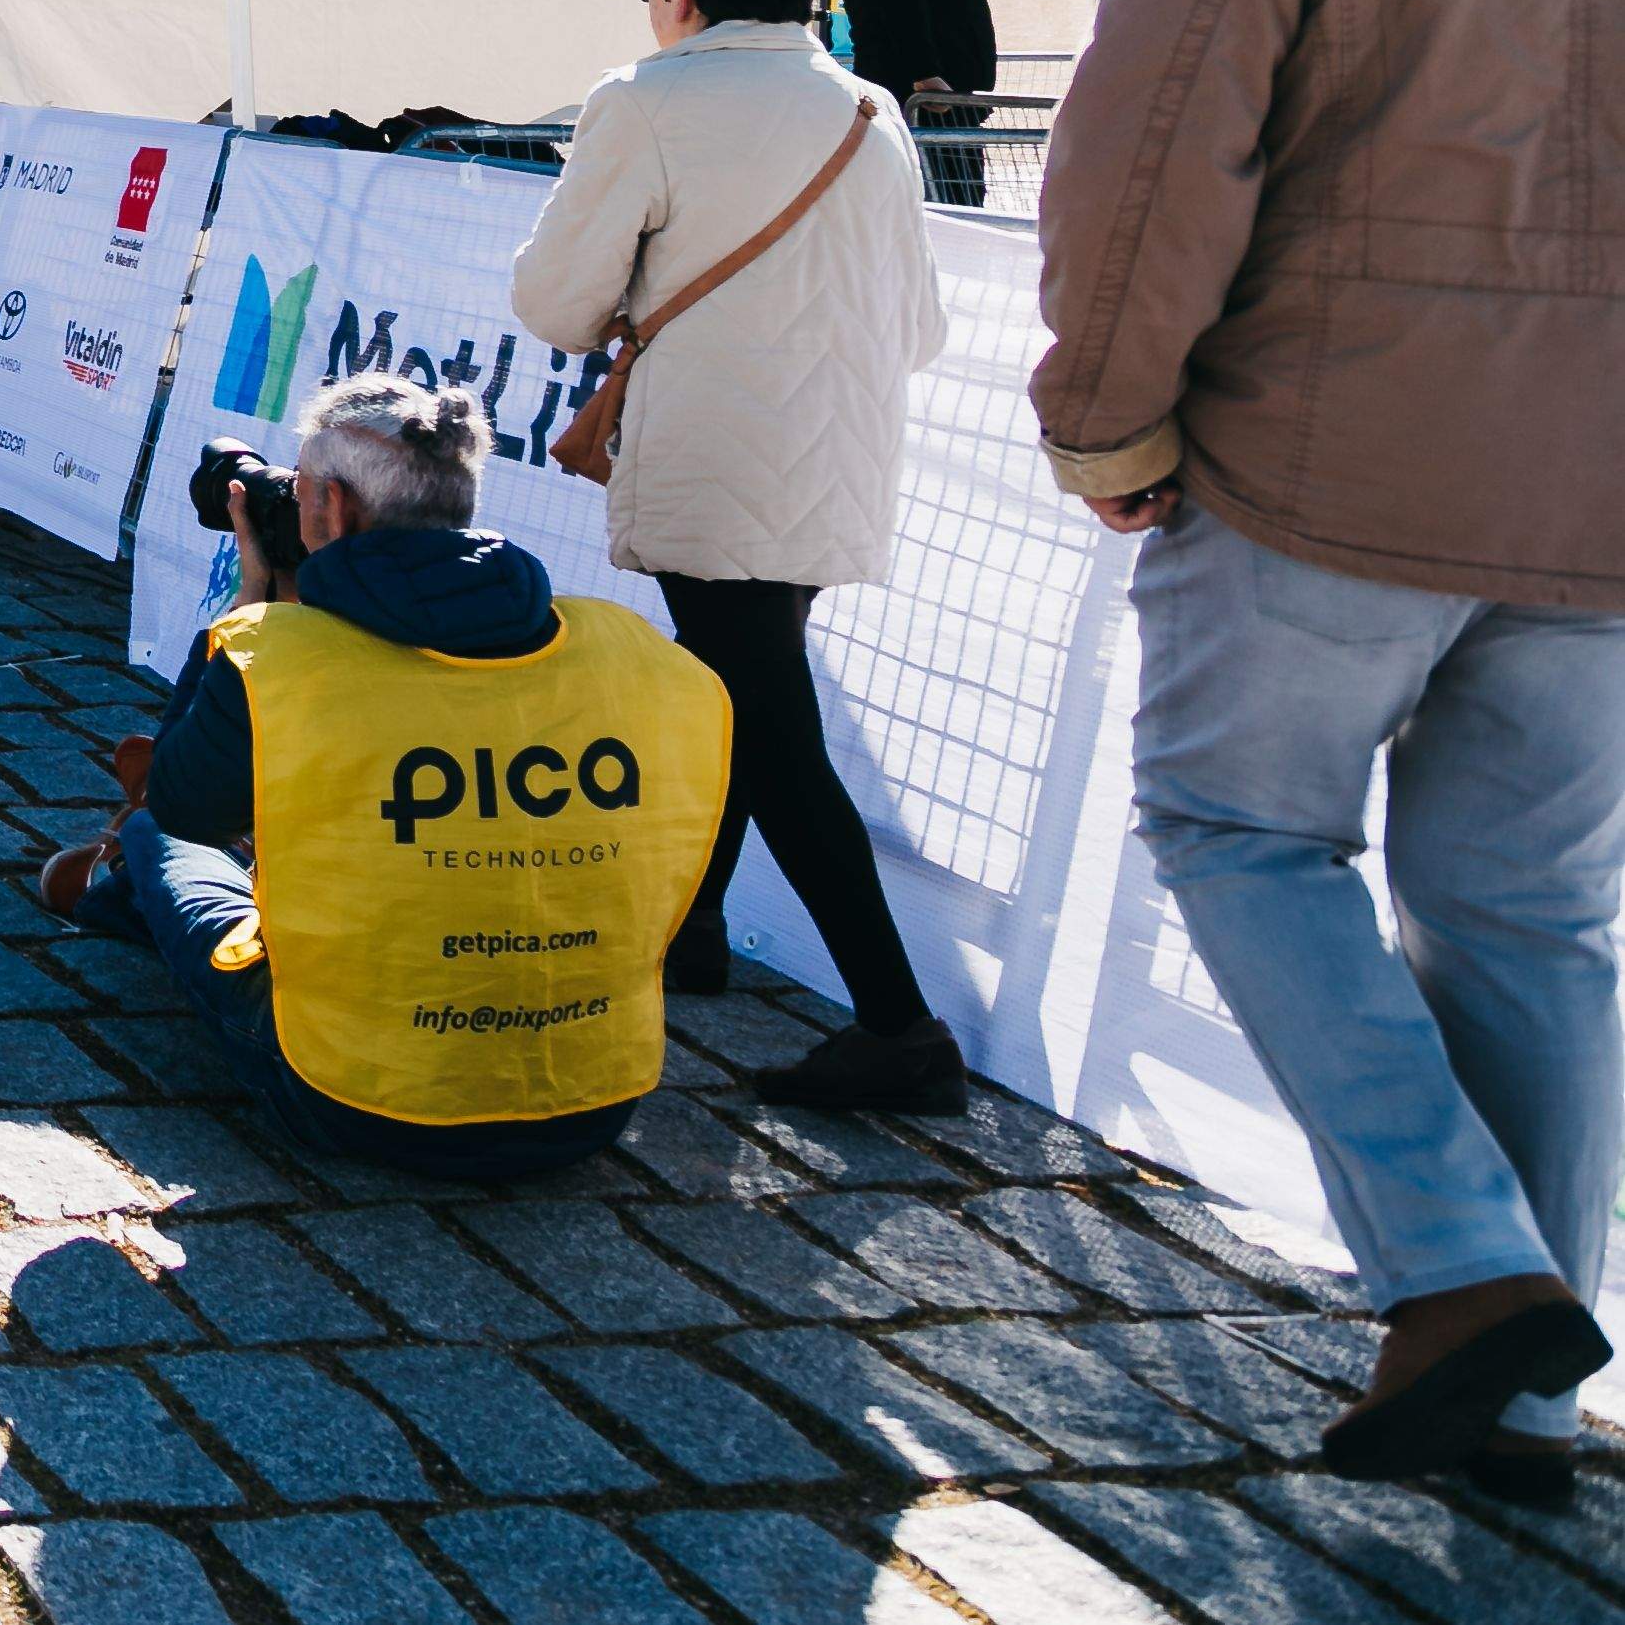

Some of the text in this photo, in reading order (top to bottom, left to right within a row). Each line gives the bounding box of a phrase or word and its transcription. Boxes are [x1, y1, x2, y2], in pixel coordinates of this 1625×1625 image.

[13, 161, 74, 195] MADRID
[115, 252, 140, 269] Madrid
[65, 319, 123, 372] Vitaldin
[86, 367, 117, 392] SPORT
[423, 840, 623, 870] TECHNOLOGY
[441, 927, 598, 959] getpica.com
[412, 995, 611, 1034] info@pixport.es
